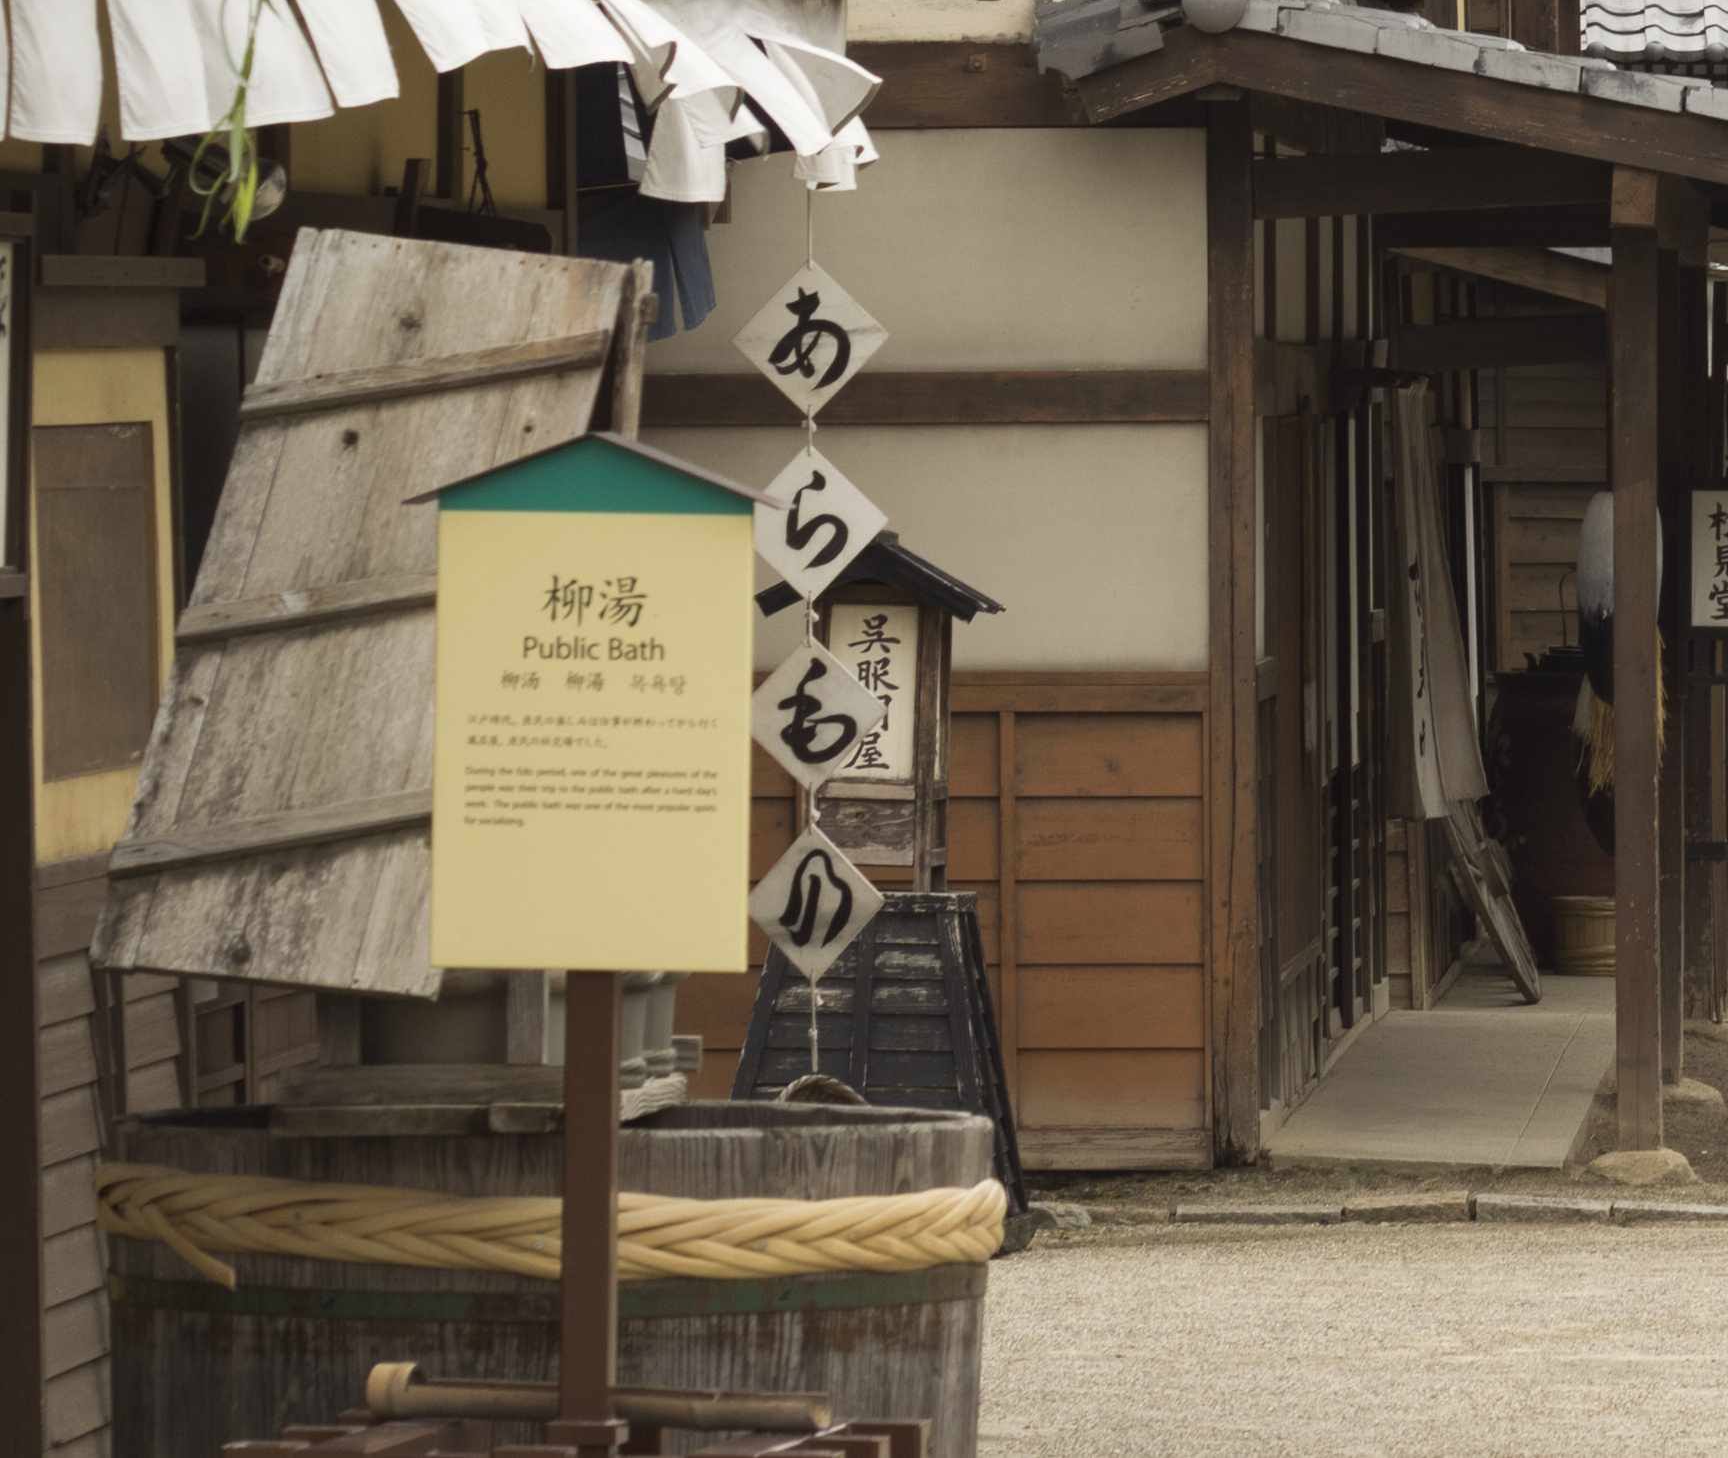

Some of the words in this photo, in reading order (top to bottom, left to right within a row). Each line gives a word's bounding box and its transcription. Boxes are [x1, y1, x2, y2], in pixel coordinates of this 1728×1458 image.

[540, 574, 648, 628] 柳湯
[522, 636, 600, 661] Public
[607, 637, 666, 662] Bath
